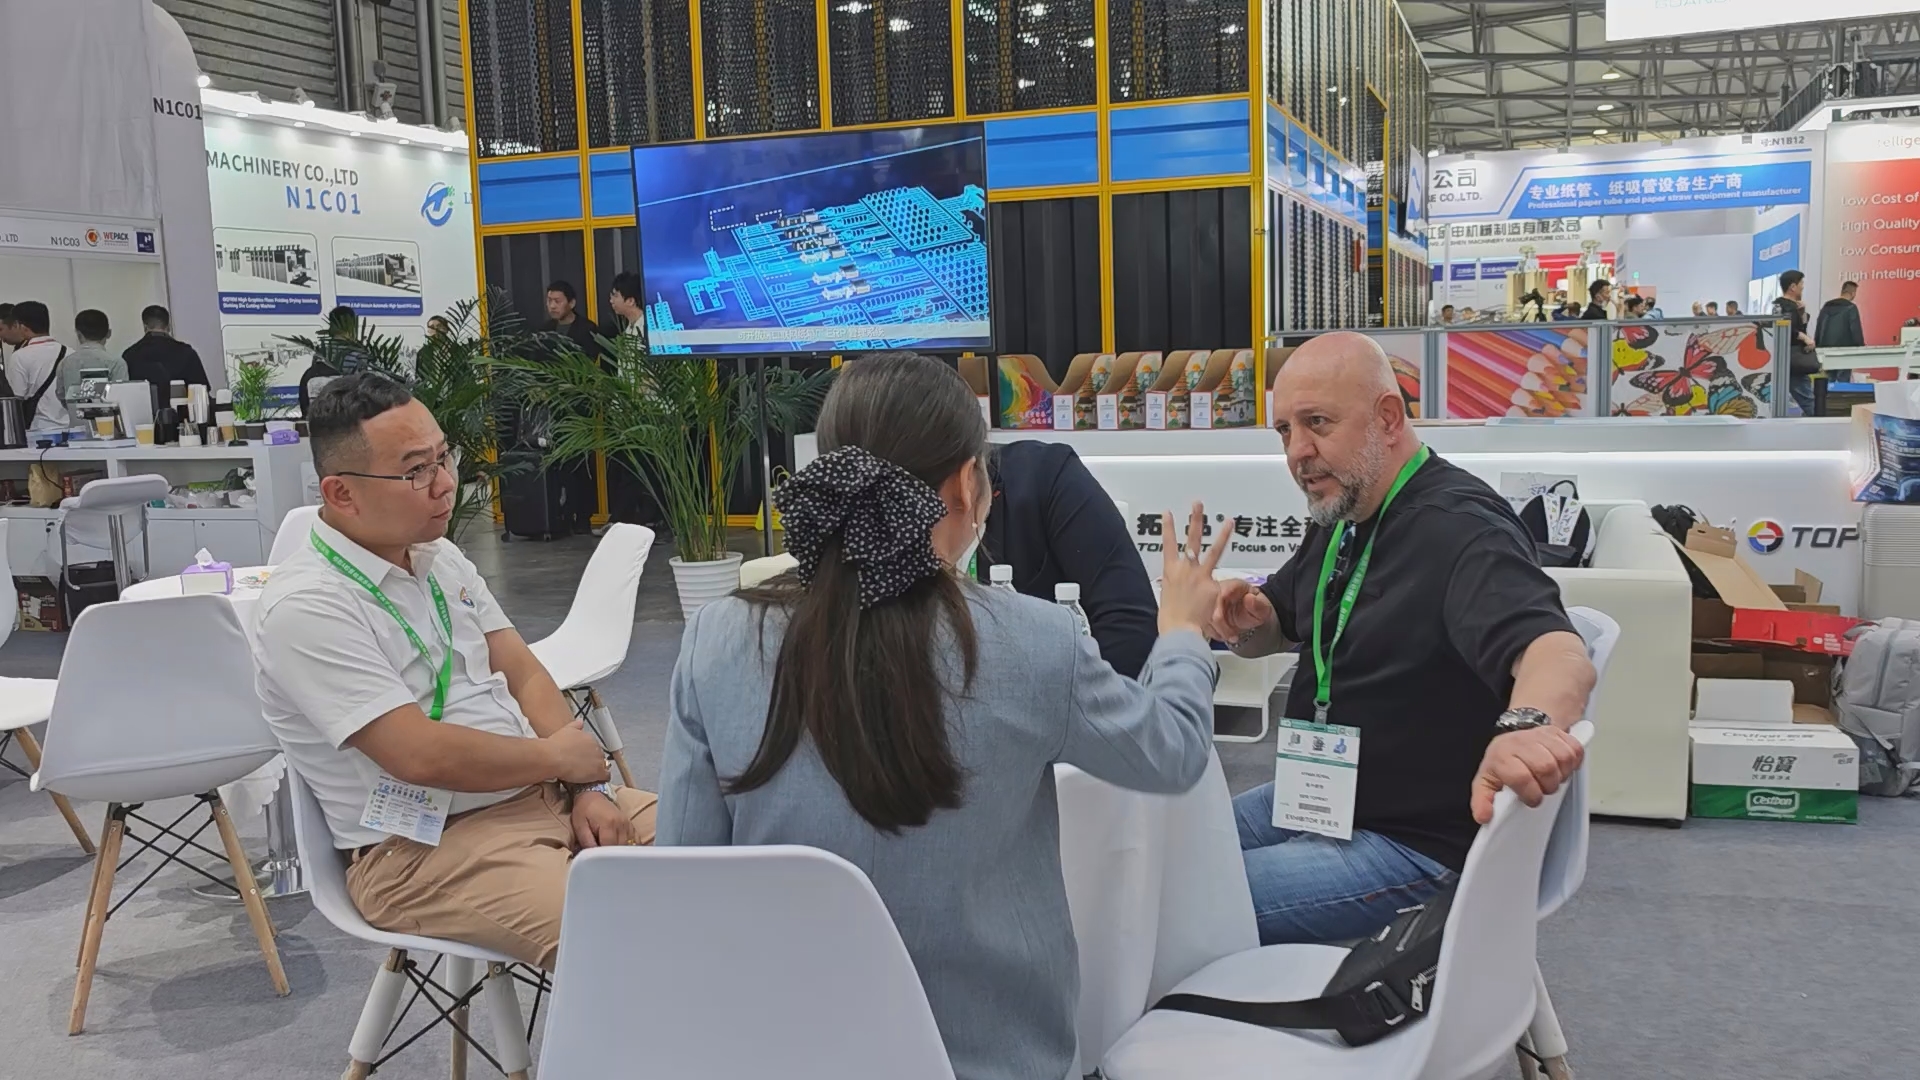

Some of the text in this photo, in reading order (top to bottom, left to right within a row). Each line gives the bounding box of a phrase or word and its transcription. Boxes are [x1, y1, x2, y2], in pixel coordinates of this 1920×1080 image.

[153, 97, 202, 120] N1C01
[206, 150, 359, 187] MACHINERY CO.,LTD
[1433, 168, 1477, 188] 公司
[1528, 173, 1743, 200] 专业纸管、纸吸管设备生产商
[286, 185, 361, 215] N1C01
[1528, 200, 1577, 209] Professional
[1578, 199, 1602, 208] paper
[1604, 198, 1623, 206] tube
[1642, 195, 1666, 204] paper
[1694, 191, 1740, 201] equipment
[1742, 187, 1802, 198] manufacturer
[1841, 191, 1919, 207] Low Cost of
[1840, 216, 1920, 233] High Quality
[51, 236, 80, 247] N1C03
[103, 231, 129, 241] WEPACK
[1840, 243, 1920, 257] Low Consum
[1839, 269, 1868, 284] High
[826, 328, 845, 338] ERP
[1792, 527, 1860, 548] TOP
[1231, 542, 1267, 553] Focus
[1269, 544, 1286, 553] on
